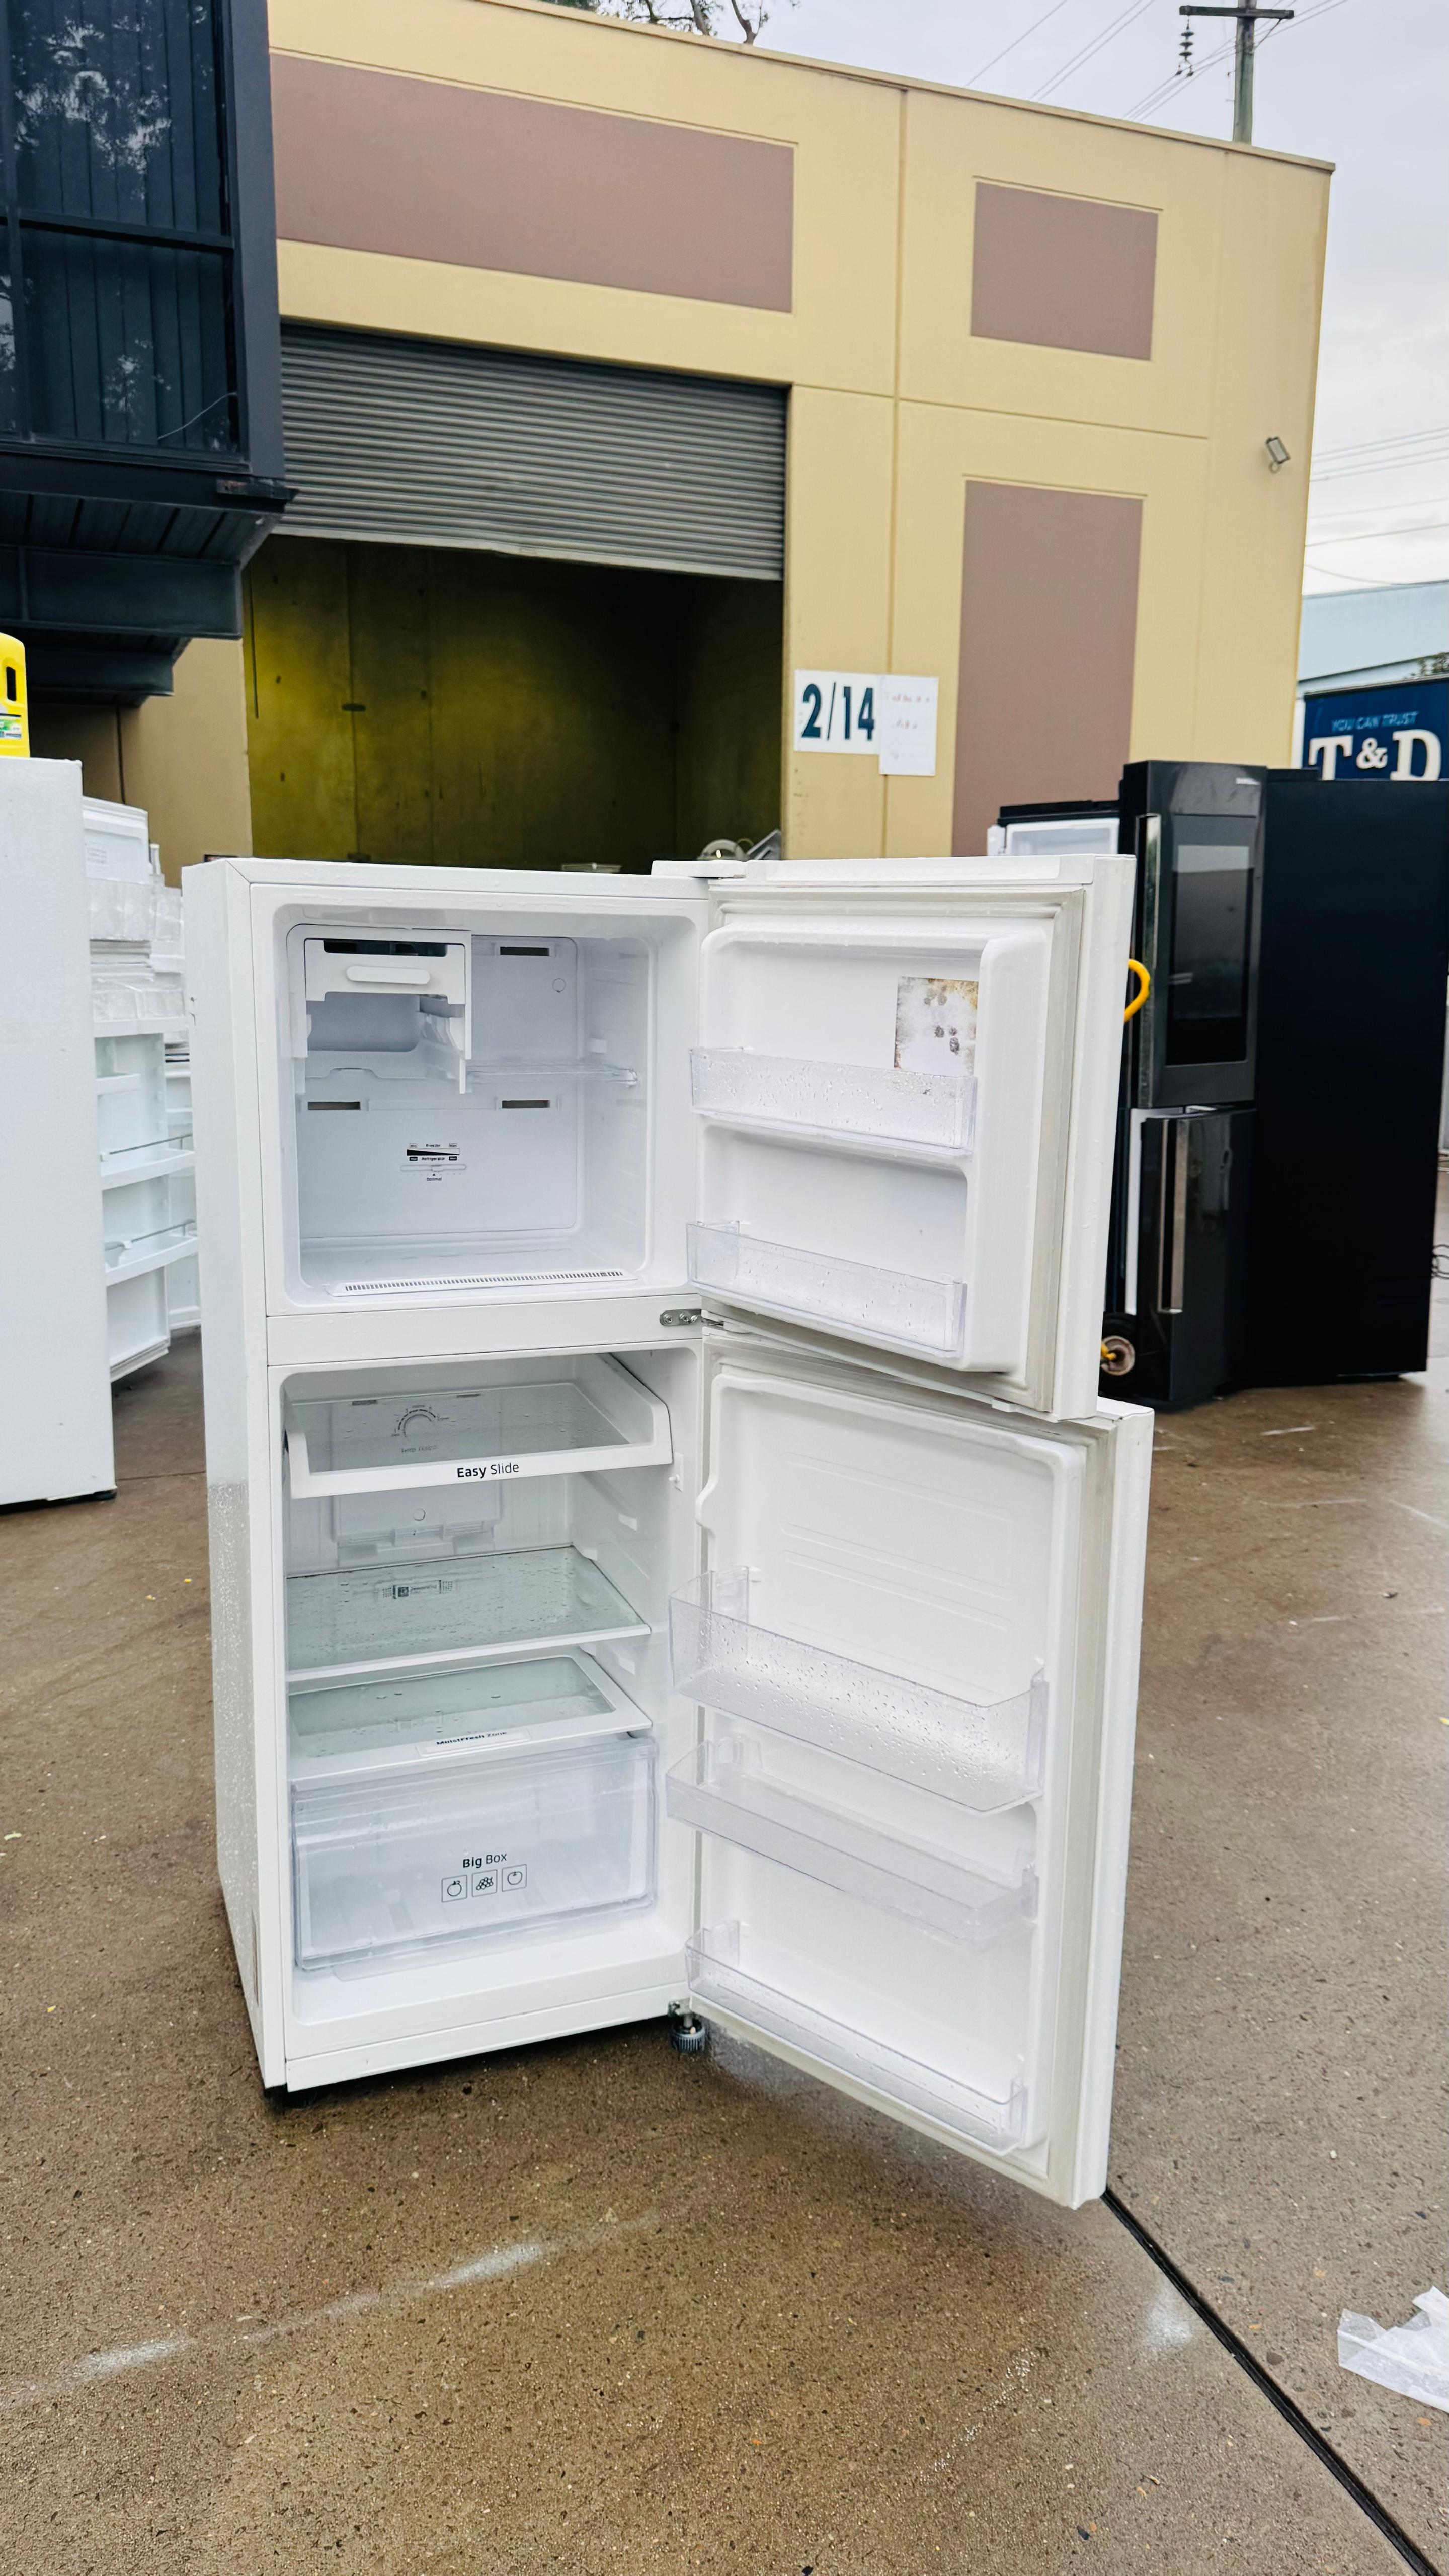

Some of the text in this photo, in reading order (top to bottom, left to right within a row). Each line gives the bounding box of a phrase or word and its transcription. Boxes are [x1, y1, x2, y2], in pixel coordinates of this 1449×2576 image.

[801, 682, 874, 741] 2/14
[1356, 715, 1380, 730] CAN
[457, 1462, 519, 1479] Easy Slide
[463, 1853, 507, 1868] Big Box
